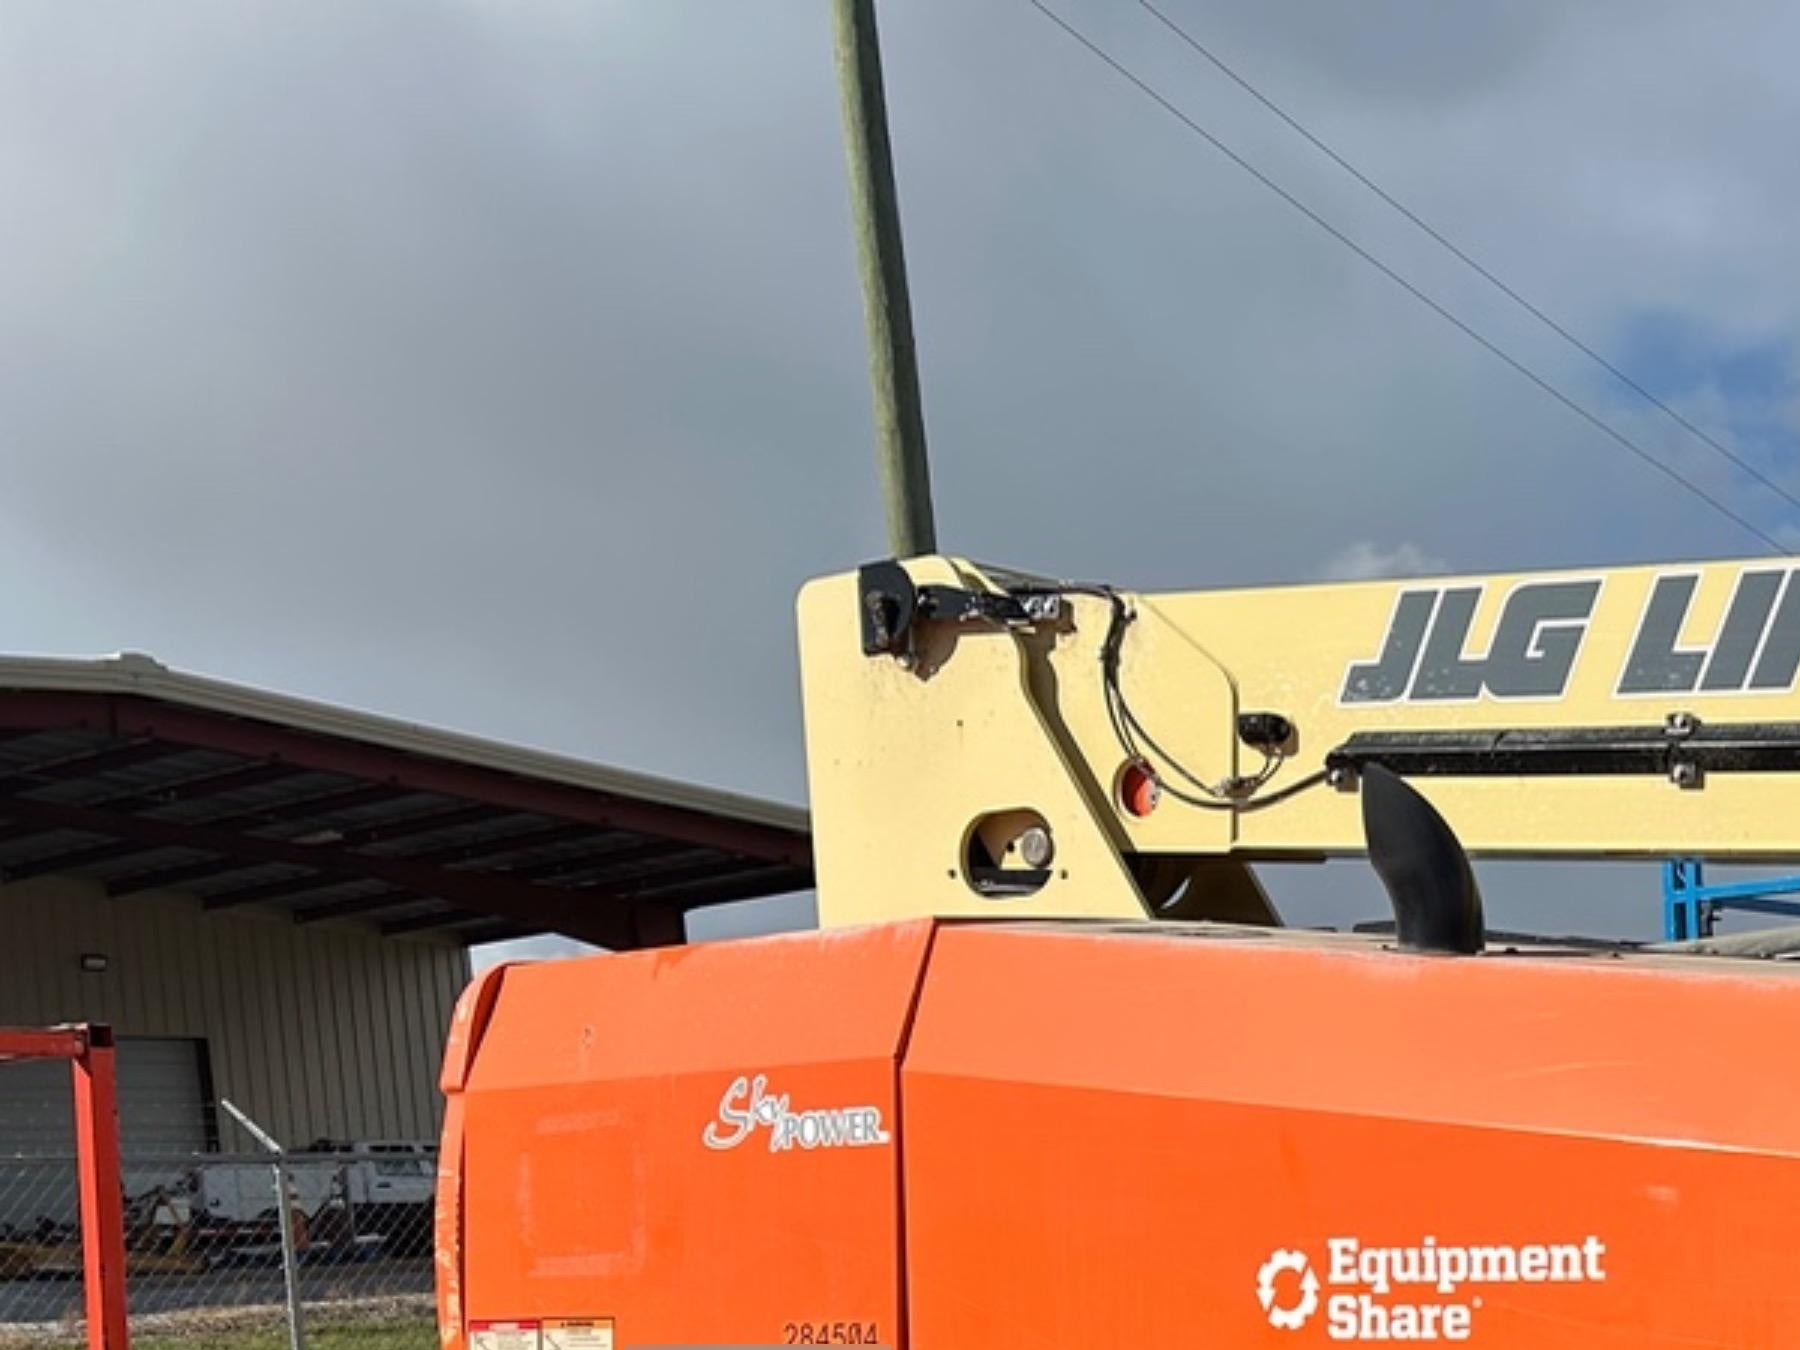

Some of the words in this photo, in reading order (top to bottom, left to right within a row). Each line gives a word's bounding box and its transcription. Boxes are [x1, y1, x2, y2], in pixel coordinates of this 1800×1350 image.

[1338, 577, 1603, 704] JLG
[1327, 1235, 1606, 1294] Equipment
[1327, 1294, 1472, 1340] Share
